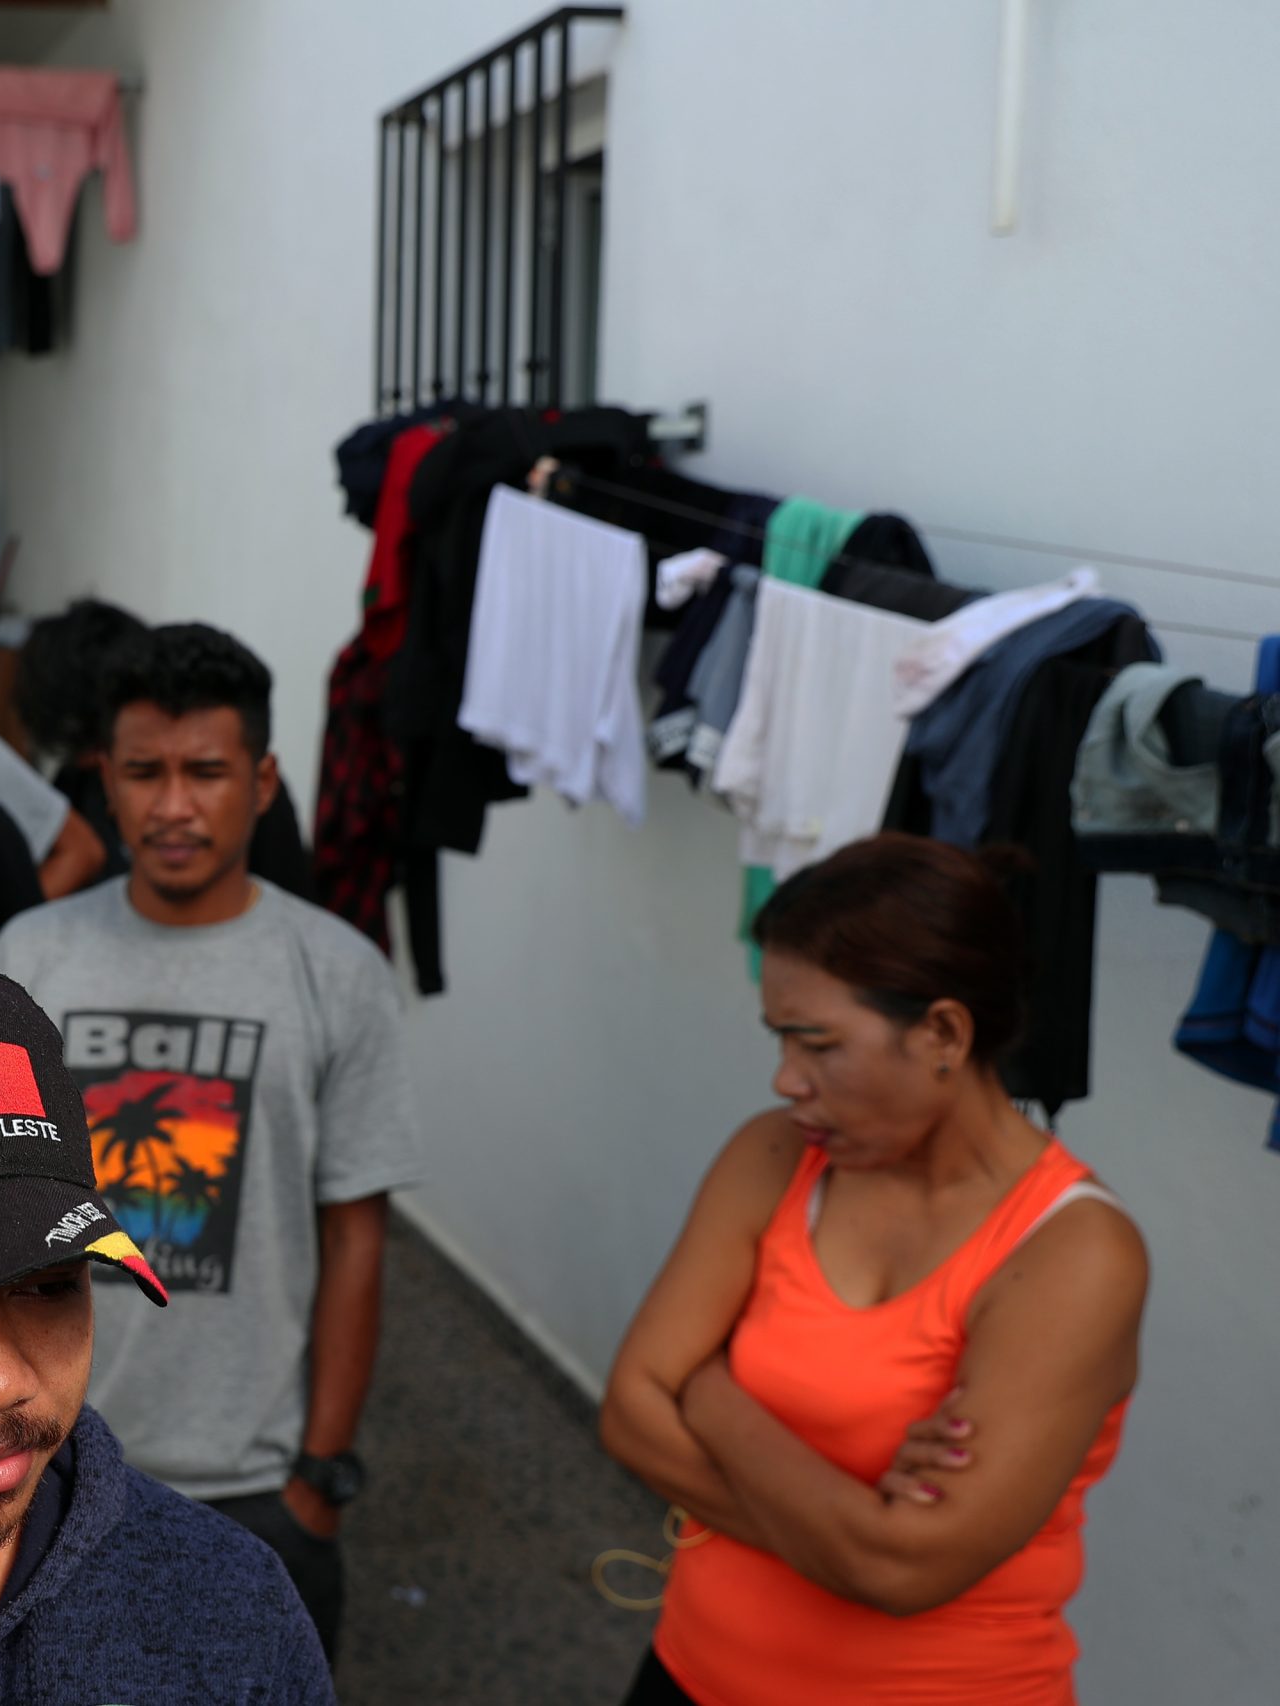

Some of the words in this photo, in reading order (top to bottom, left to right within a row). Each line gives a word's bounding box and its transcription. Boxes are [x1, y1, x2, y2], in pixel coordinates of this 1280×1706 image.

[64, 1014, 262, 1080] Bali
[0, 1118, 62, 1142] LESTE
[44, 1211, 92, 1248] TIMOR
